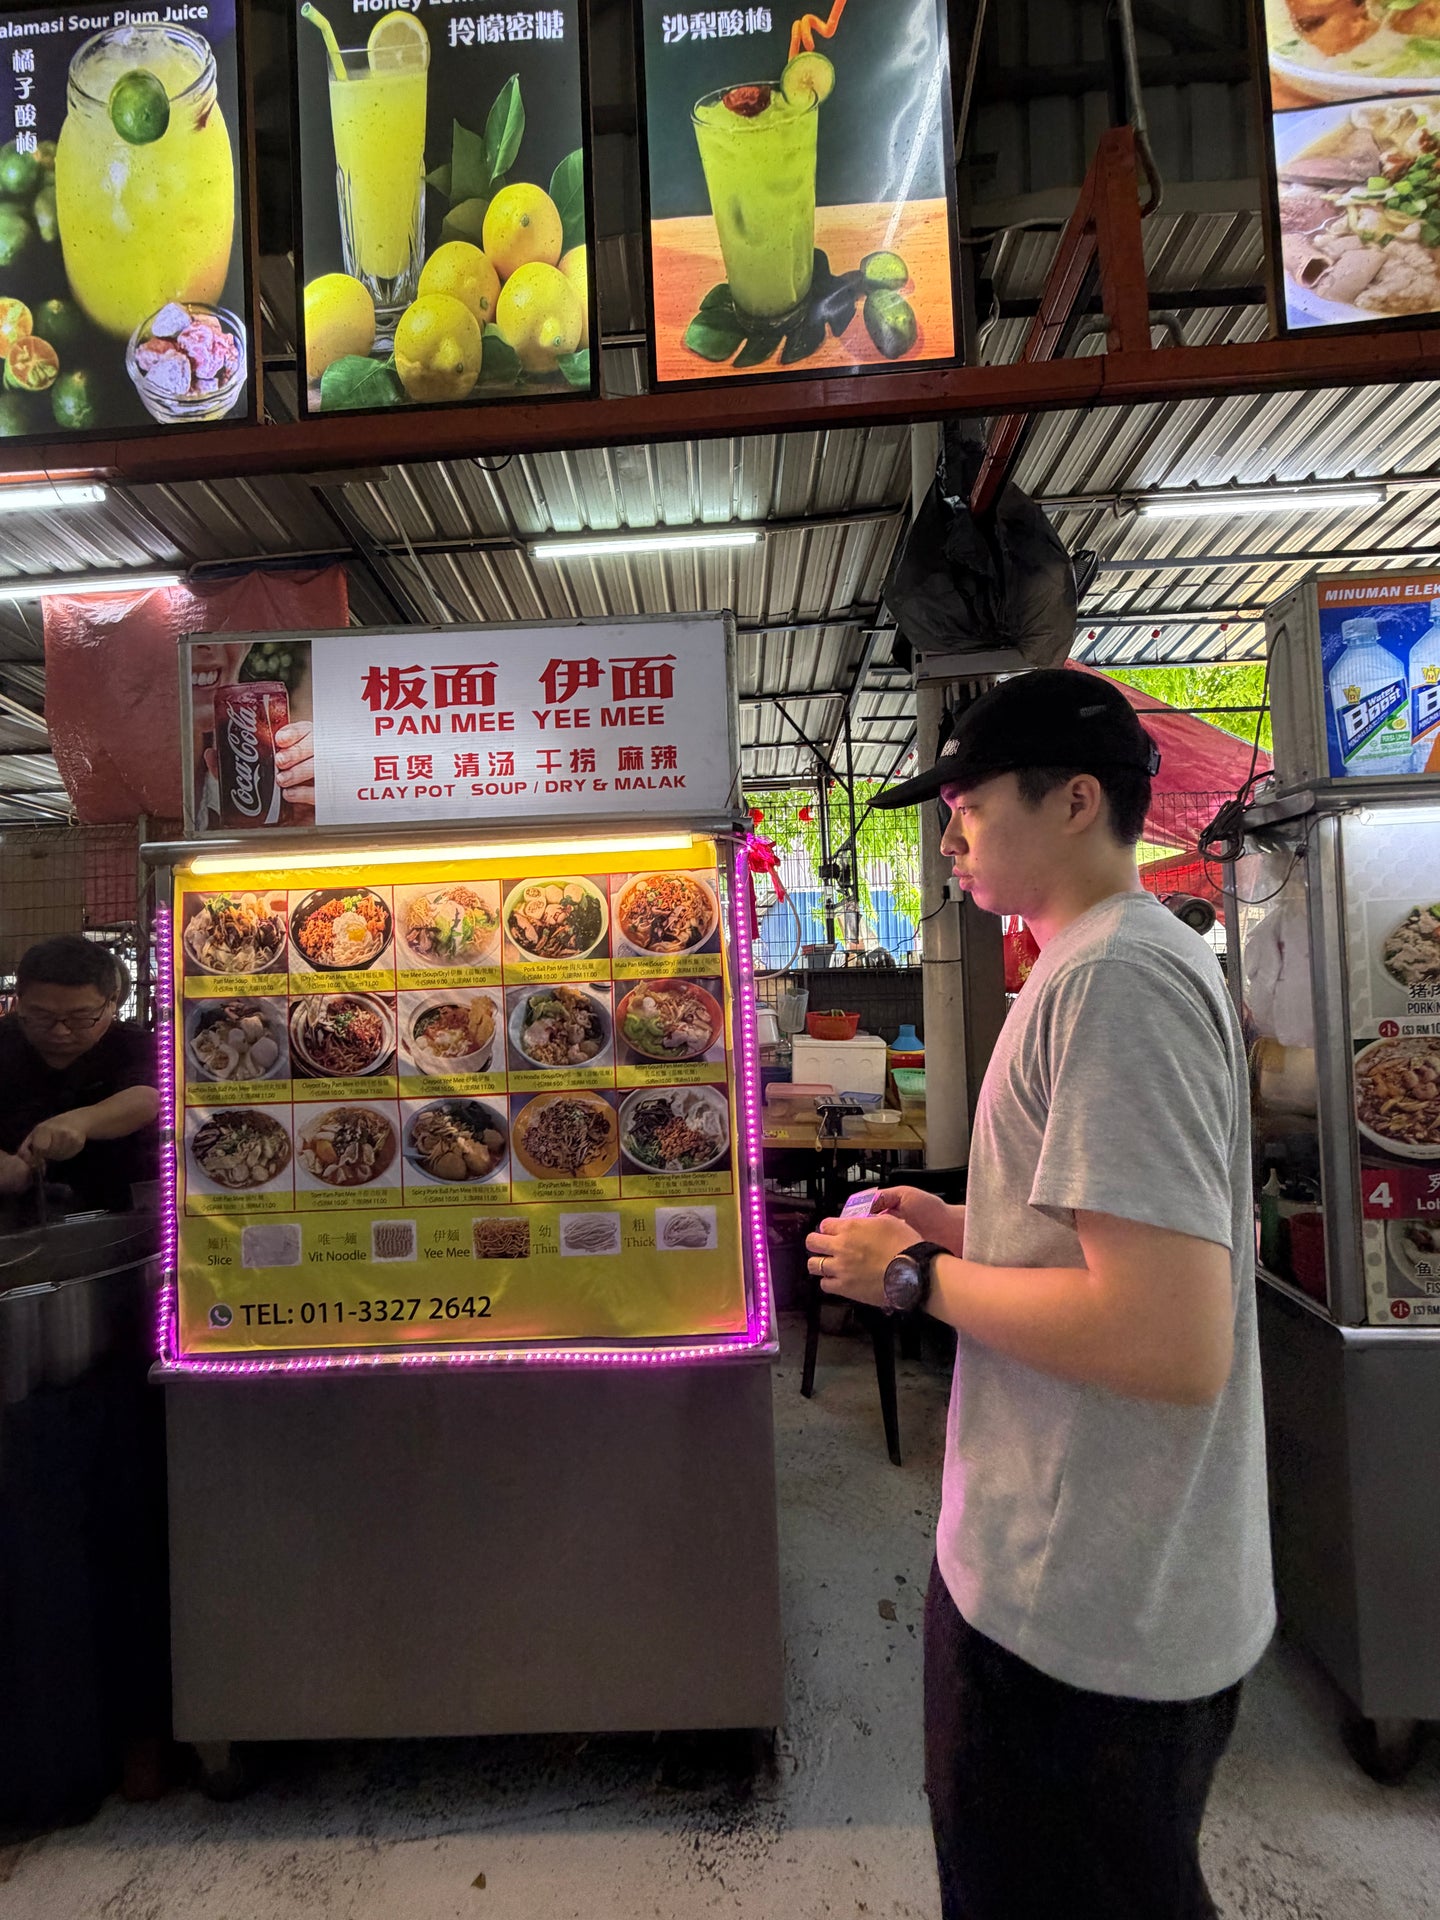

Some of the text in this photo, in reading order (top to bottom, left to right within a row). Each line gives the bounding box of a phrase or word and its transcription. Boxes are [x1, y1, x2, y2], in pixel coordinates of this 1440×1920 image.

[69, 15, 109, 31] Sour
[114, 9, 159, 26] Plum
[163, 4, 208, 22] Juice
[662, 6, 772, 44] 沙梨酸梅
[12, 48, 37, 155] 橘子酸梅
[1325, 586, 1401, 601] MINUMAN
[361, 653, 677, 712] 板面 伊面
[1368, 685, 1396, 706] Water
[375, 705, 664, 736] PAN MEE YEE MEE
[1343, 687, 1401, 741] Boost
[373, 745, 677, 781] 瓦煲 清汤 干捞 麻辣
[357, 775, 686, 800] CLAY POT SOUP / DRY & MALAK
[1408, 1002, 1433, 1014] PORK
[1402, 1025, 1414, 1035] (S)
[1416, 1025, 1429, 1034] RM
[1368, 1182, 1393, 1208] 4
[538, 1225, 552, 1238] 幼
[632, 1218, 646, 1232] 粗
[424, 1246, 470, 1259] Yee Mee
[533, 1243, 558, 1255] Thin
[624, 1236, 655, 1248] Thick
[207, 1254, 233, 1266] Slice
[308, 1249, 367, 1263] Vit Noodle
[240, 1296, 491, 1326] TEL: 011-3327 2642
